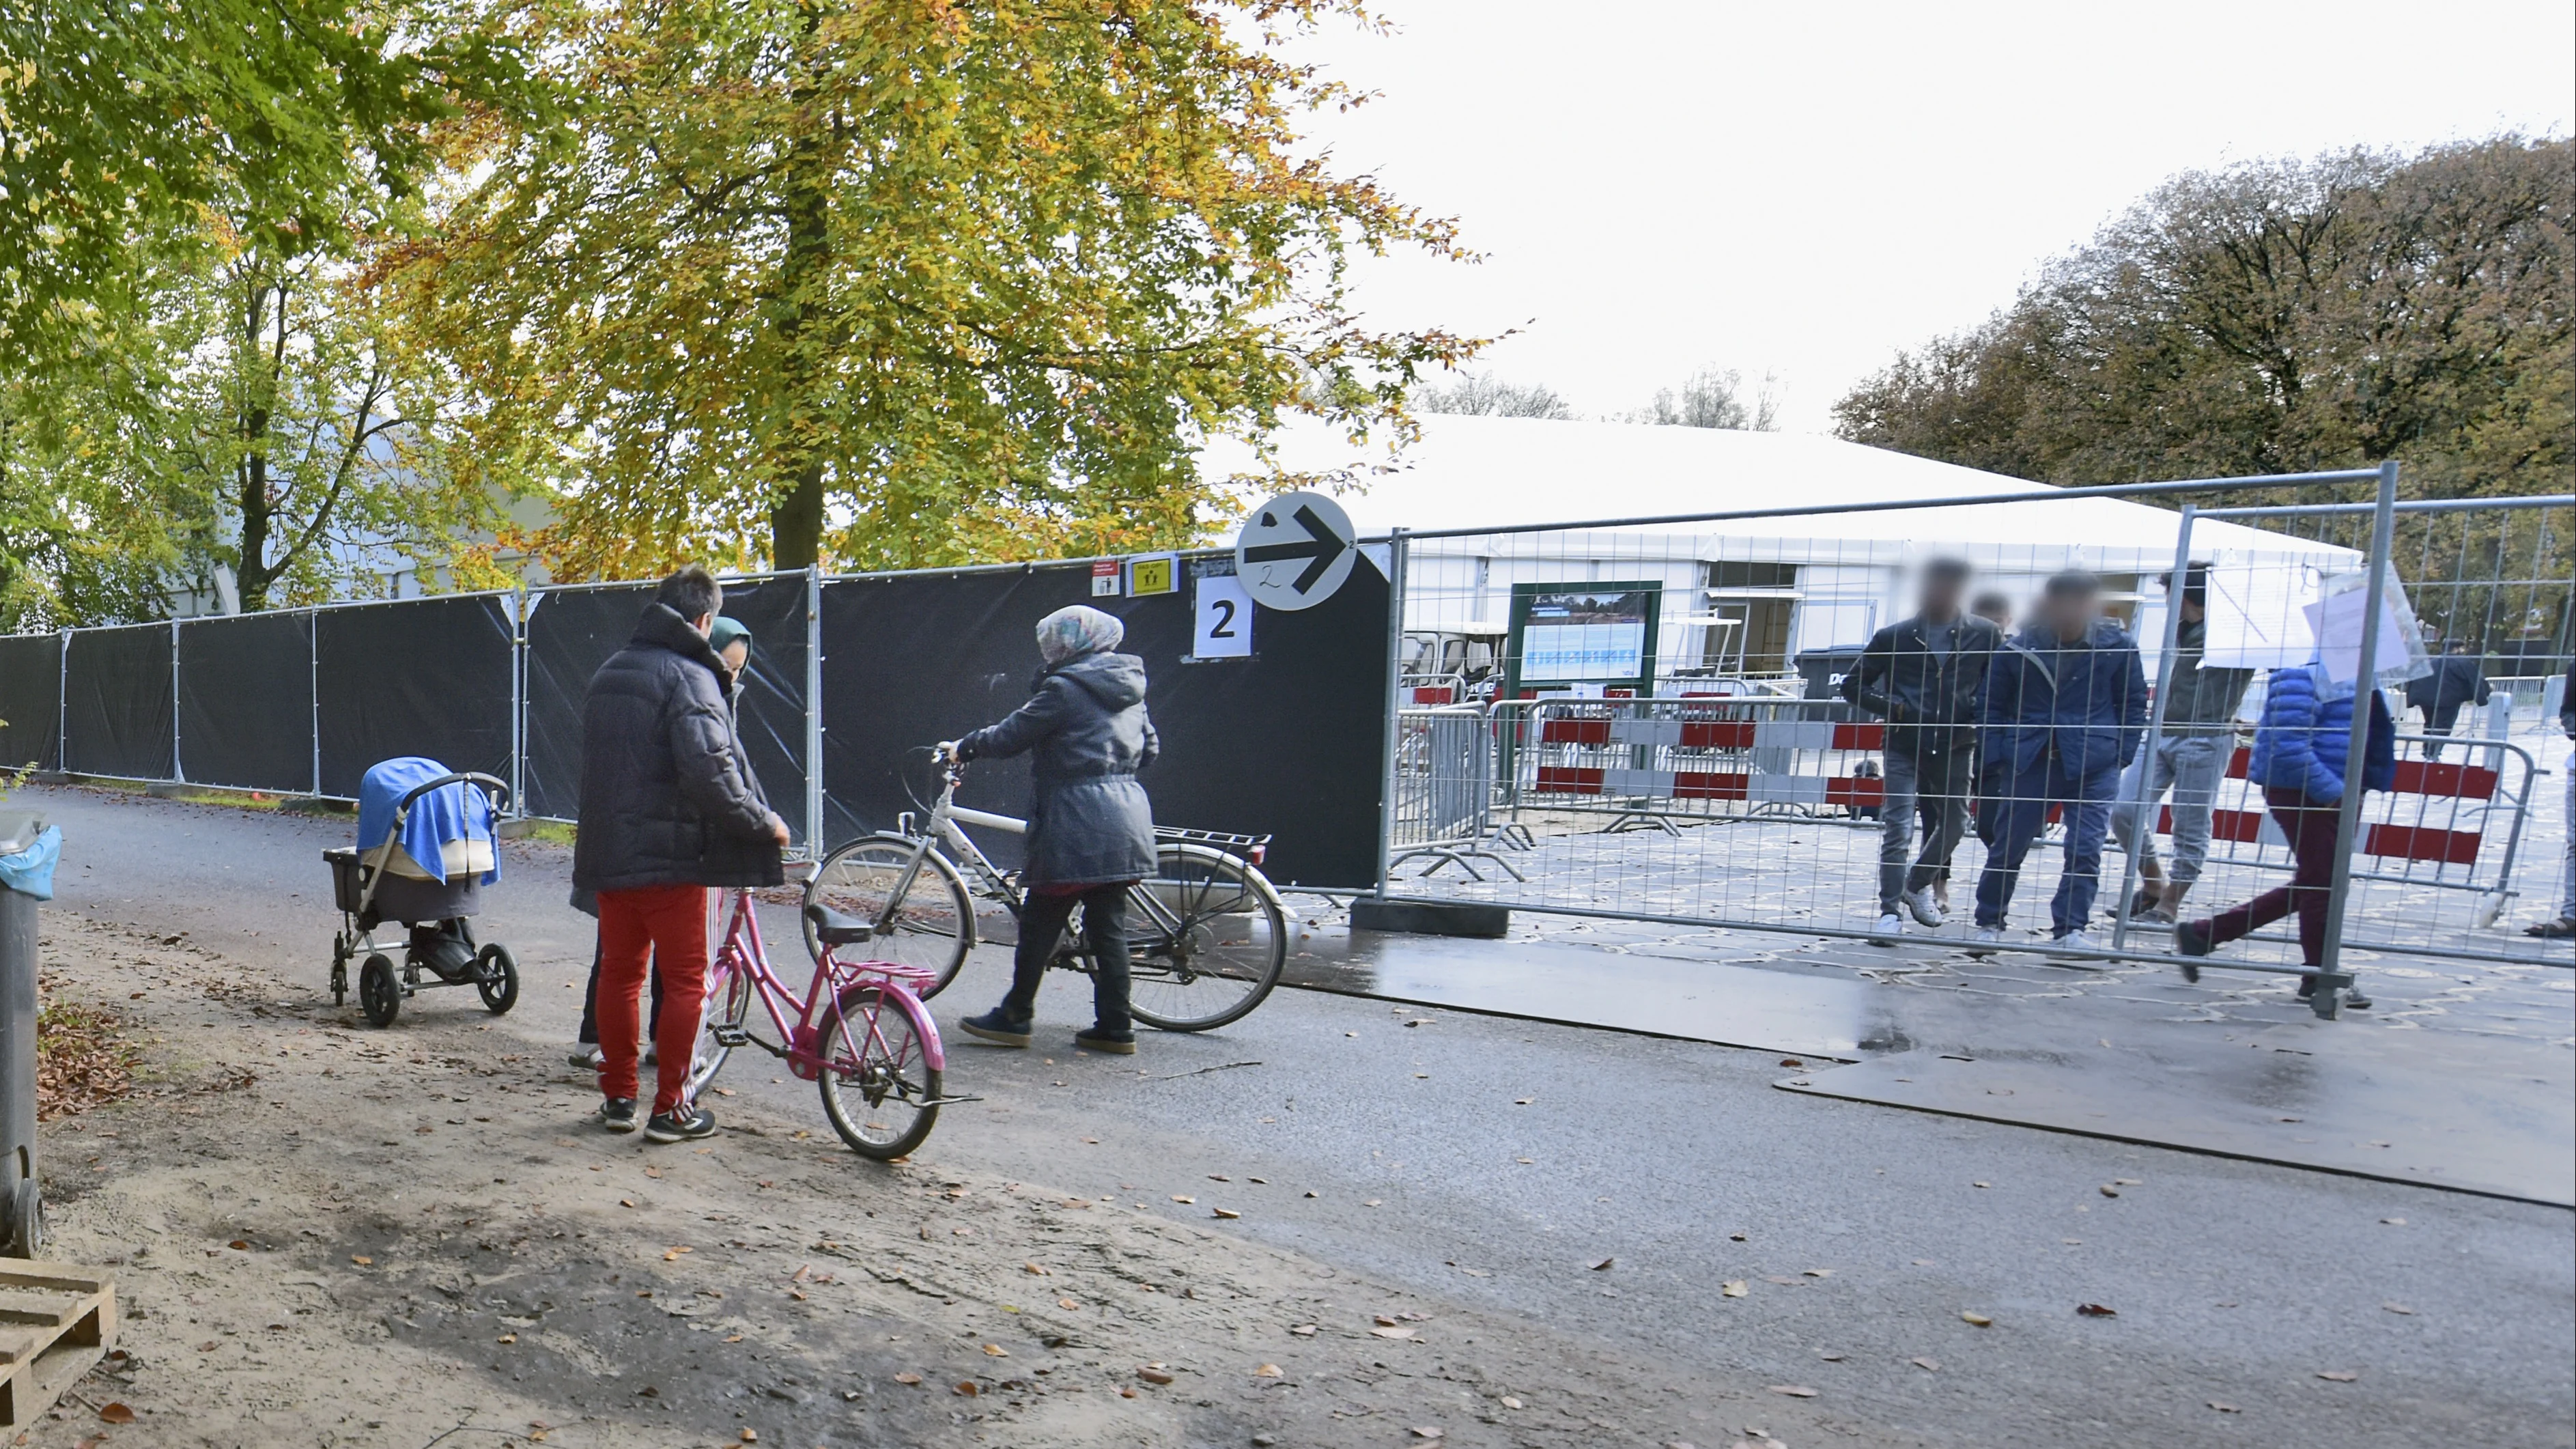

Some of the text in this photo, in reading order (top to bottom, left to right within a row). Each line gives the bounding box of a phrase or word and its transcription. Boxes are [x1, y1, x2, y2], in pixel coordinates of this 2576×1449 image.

[1348, 540, 1355, 550] 2
[1259, 565, 1282, 588] 2
[1210, 600, 1235, 638] 2
[1828, 673, 1848, 686] Da
